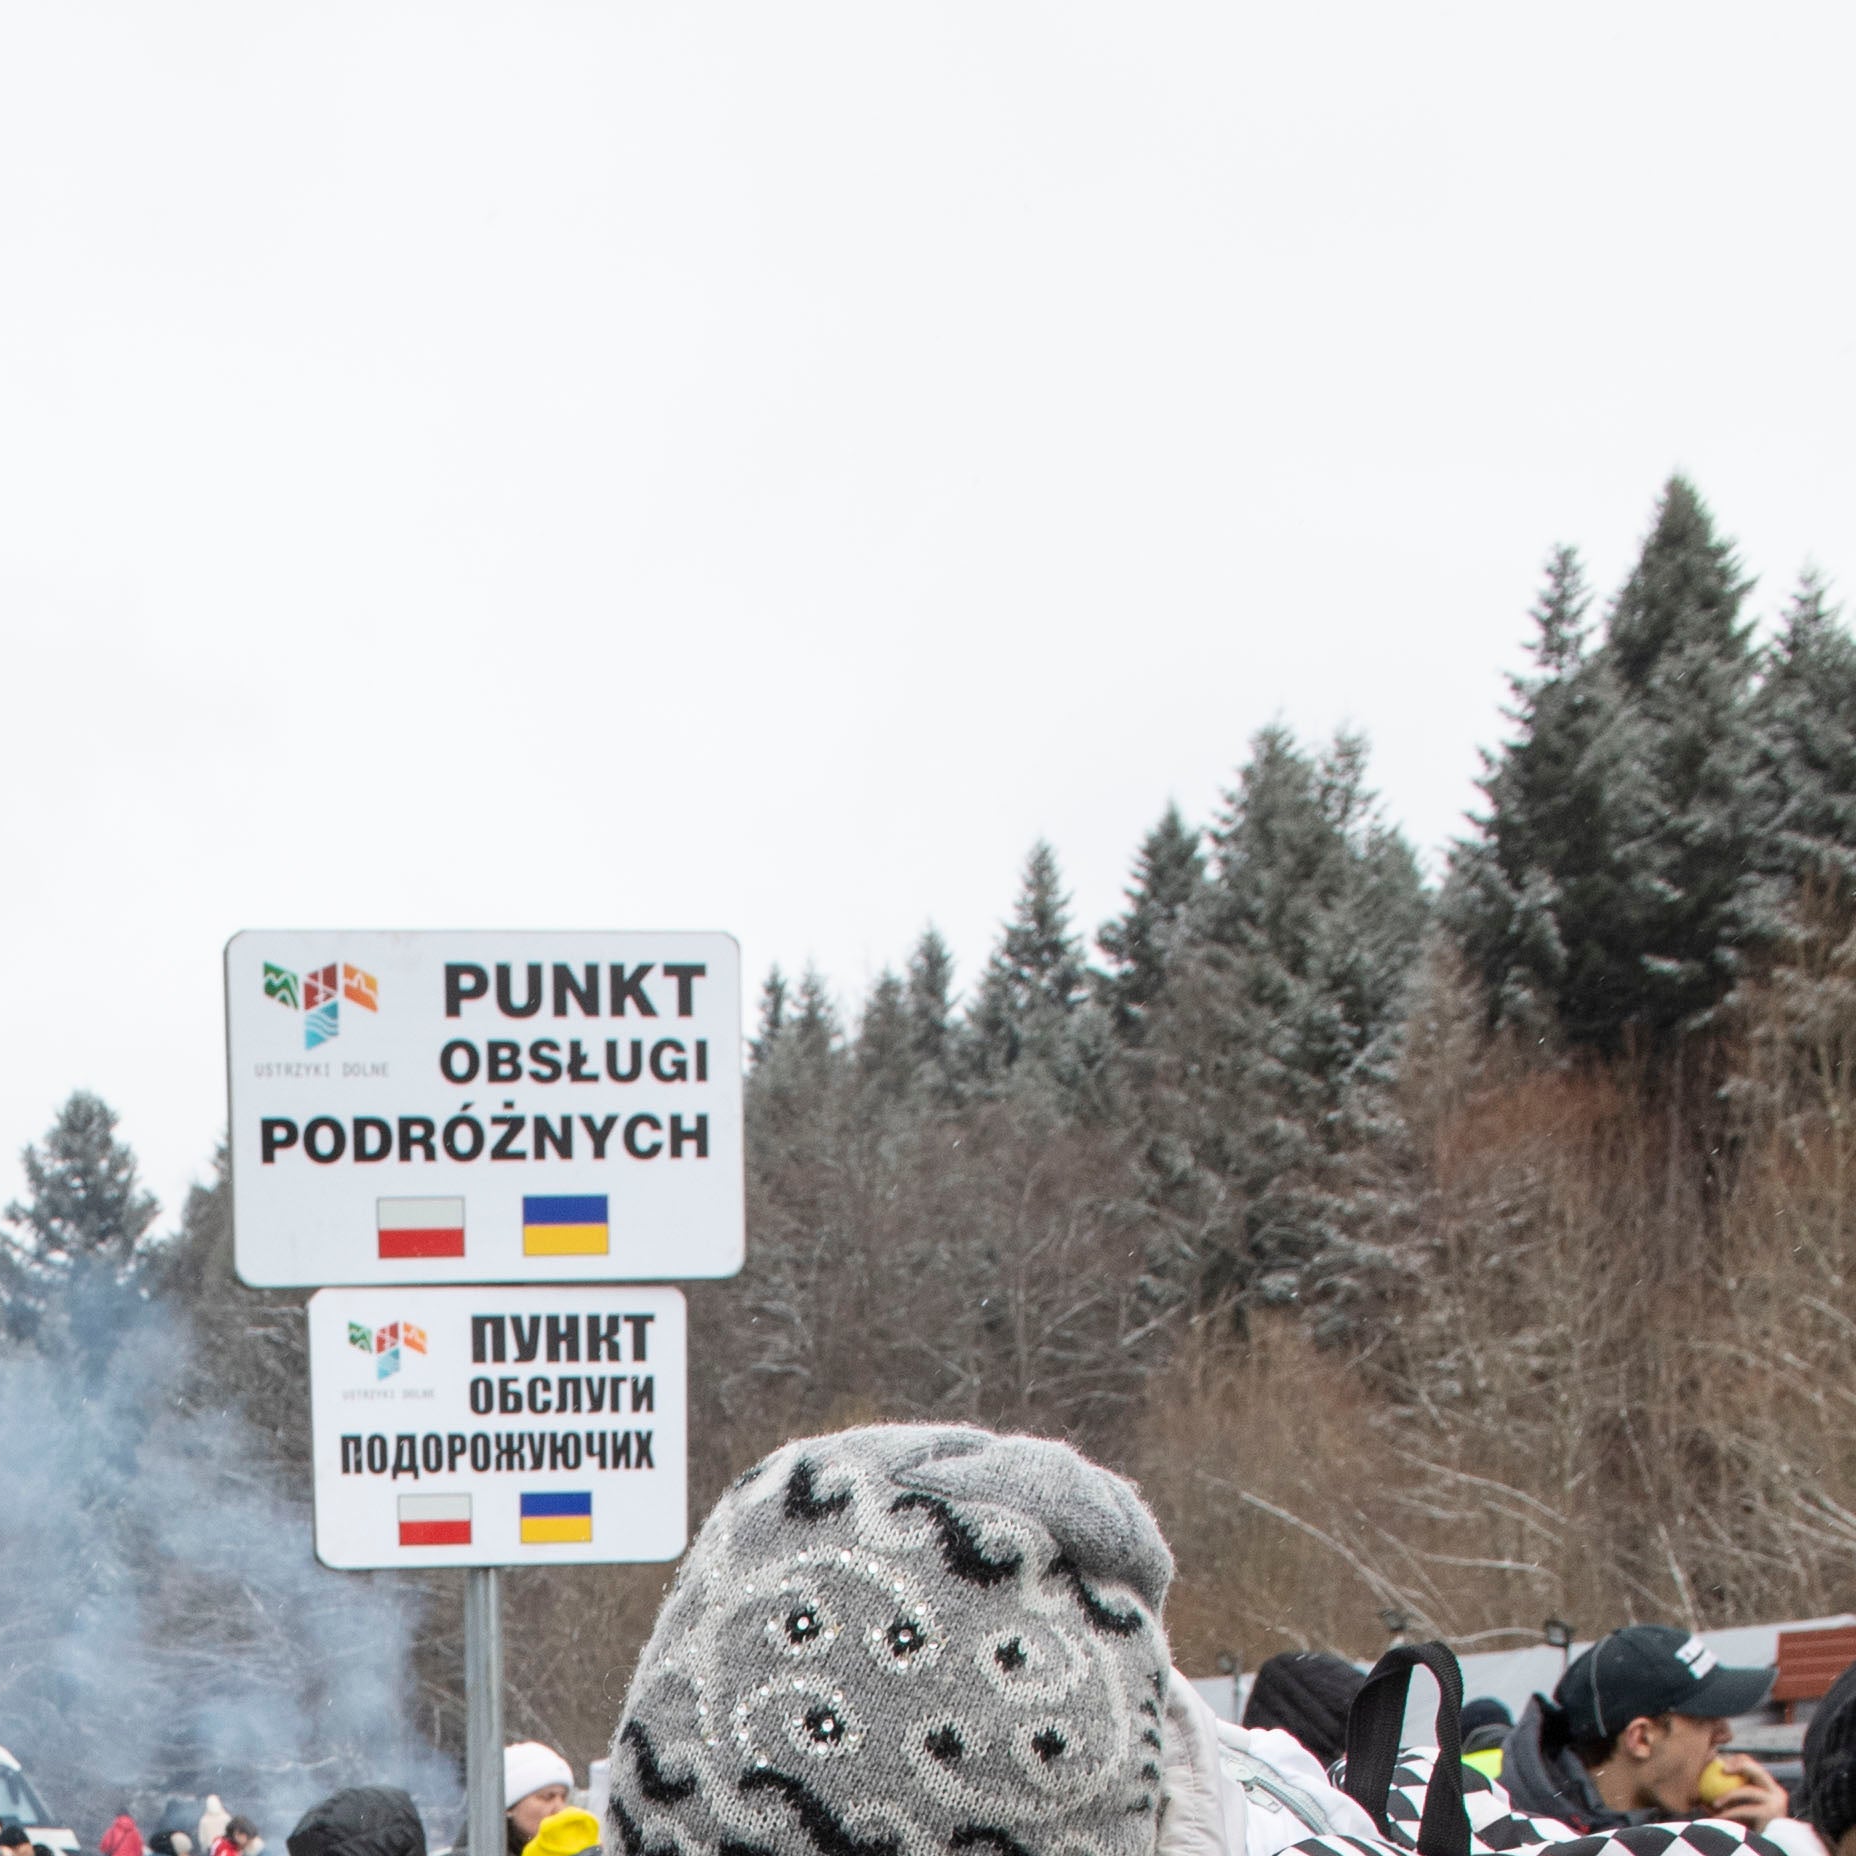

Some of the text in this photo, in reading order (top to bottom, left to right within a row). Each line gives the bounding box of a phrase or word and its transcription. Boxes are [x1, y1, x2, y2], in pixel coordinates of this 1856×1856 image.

[445, 964, 706, 1018] PUNKT
[254, 1062, 389, 1078] USTRZYKI DOLNE
[440, 1039, 708, 1084] OBSŁUGI
[261, 1102, 709, 1164] PODRÓŻNYCH
[472, 1315, 655, 1364] ПУНКТ
[470, 1376, 654, 1415] ОБСЛУГИ
[342, 1431, 655, 1479] ПОДОРОЖУЮЧИХ
